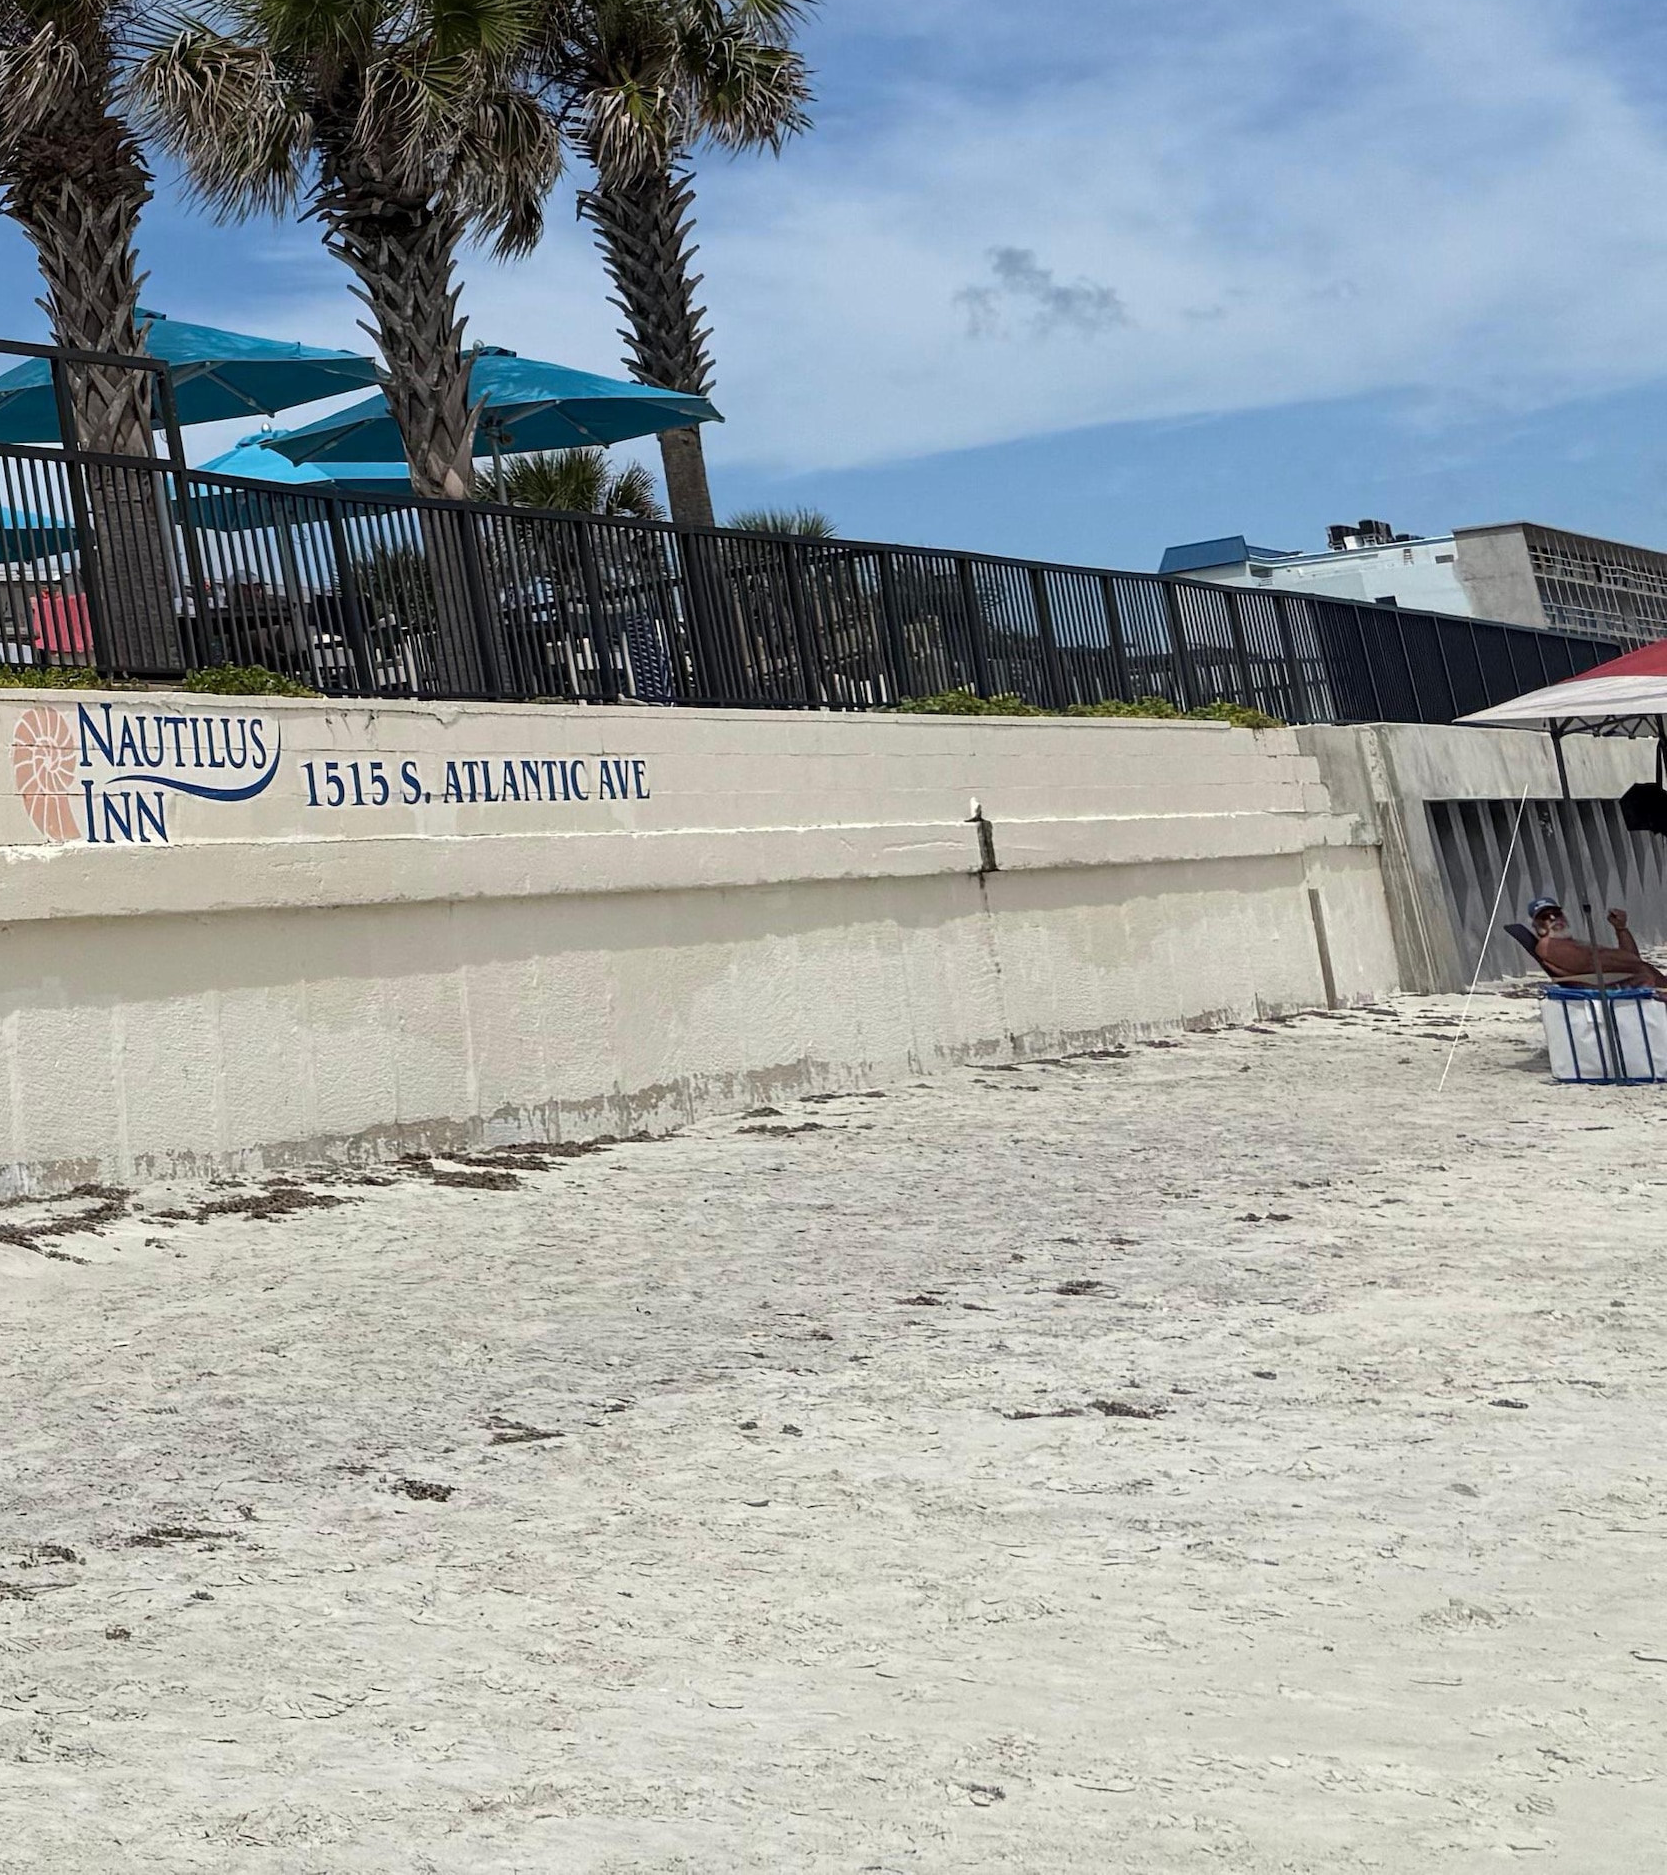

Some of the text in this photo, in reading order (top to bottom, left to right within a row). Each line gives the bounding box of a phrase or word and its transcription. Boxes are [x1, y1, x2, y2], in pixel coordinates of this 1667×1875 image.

[77, 702, 268, 770] NAUTILUS
[81, 779, 169, 843] INN
[300, 759, 651, 808] 1515 S. ATLANTIC AVE
